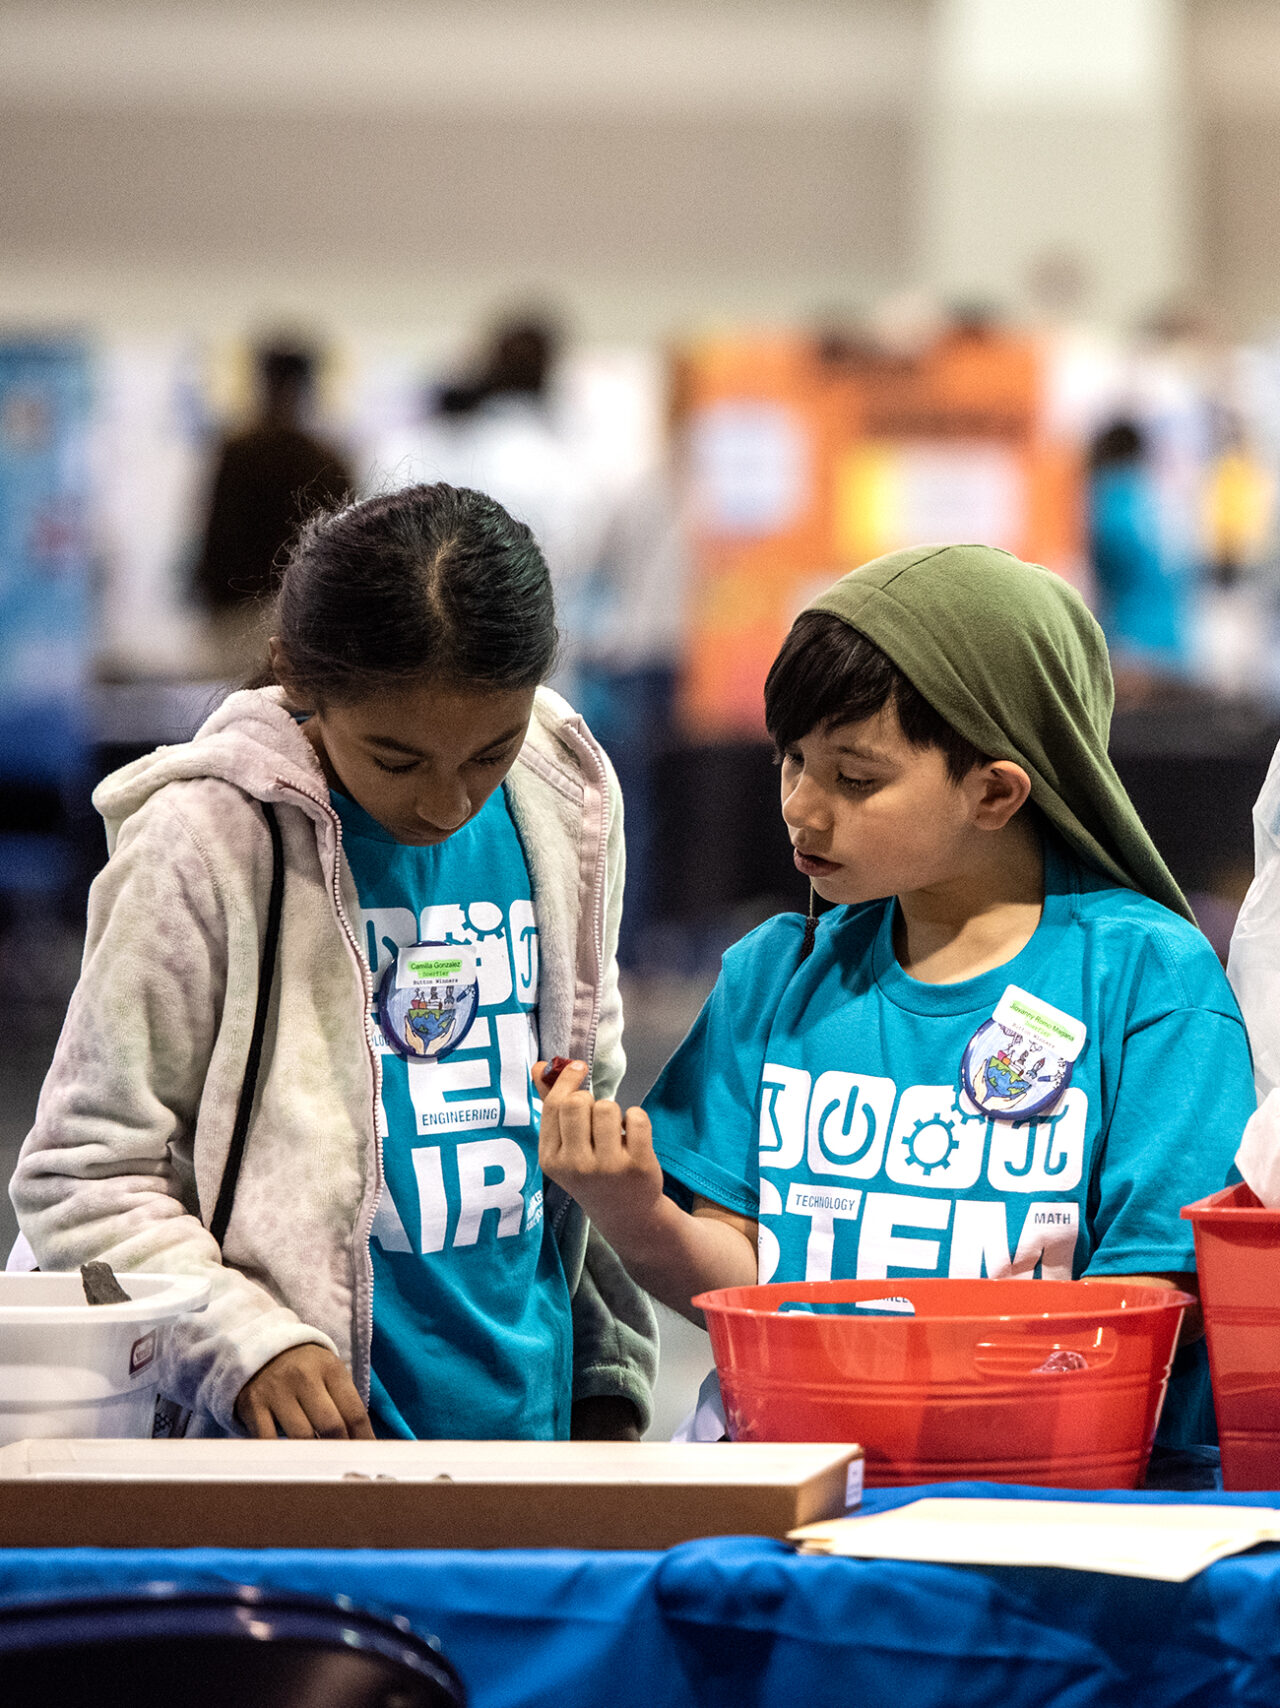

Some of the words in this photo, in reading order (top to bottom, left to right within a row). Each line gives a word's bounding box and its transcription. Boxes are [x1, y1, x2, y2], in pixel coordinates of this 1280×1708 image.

[422, 1107, 498, 1126] ENGINEERING
[794, 1194, 856, 1212] TECHNOLOGY
[1034, 1212, 1072, 1225] MATH
